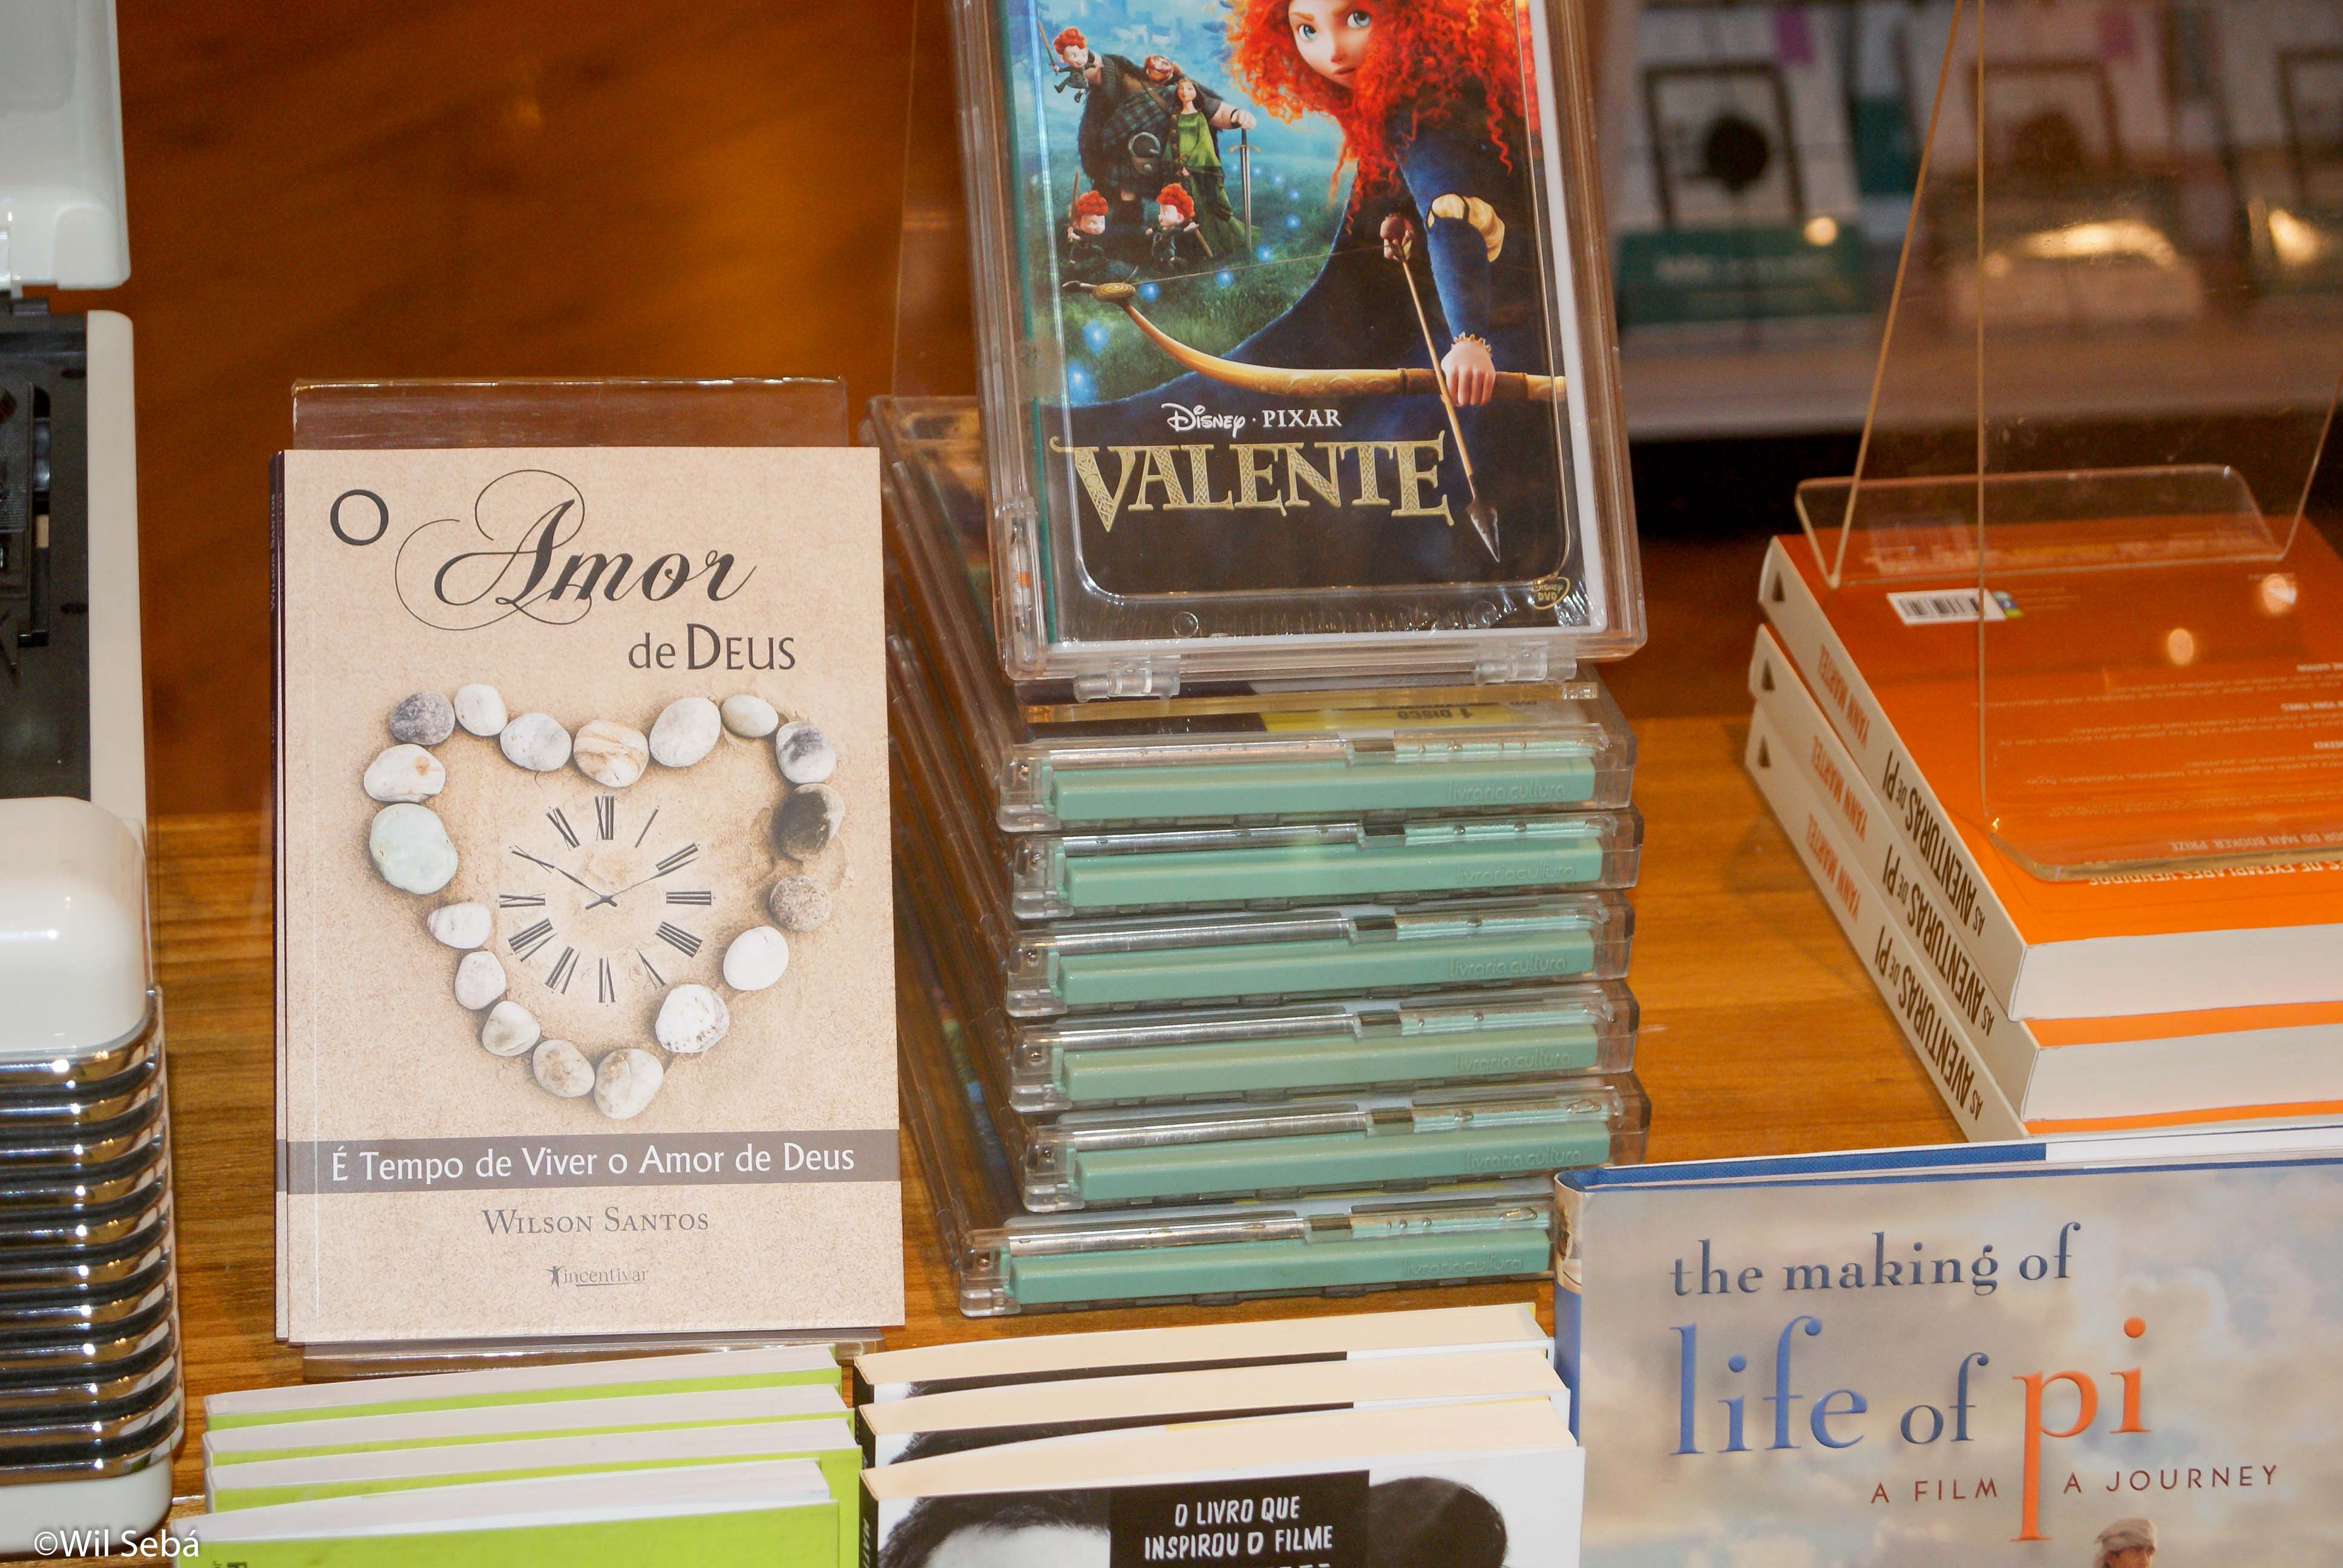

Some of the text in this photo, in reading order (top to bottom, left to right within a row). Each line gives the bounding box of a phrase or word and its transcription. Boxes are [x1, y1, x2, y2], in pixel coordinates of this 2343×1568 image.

[1262, 409, 1342, 428] PIXAR
[1049, 430, 1454, 533] VALENTE
[330, 489, 388, 546] O
[395, 469, 756, 630] Amor
[1537, 592, 1558, 601] DVD
[629, 631, 675, 670] de
[1397, 709, 1453, 720] DISCO
[1818, 642, 1870, 750] YANN MARTEL
[1811, 736, 1868, 842] YANN MARTEL
[1806, 812, 1861, 923] YANN MARTEL
[1883, 750, 1986, 938] AS AVENTURAS DE PI
[1883, 844, 1995, 1037] AS AVENTURAS DE PI
[1875, 926, 1984, 1122] AS AVENTURAS DE PI
[331, 1142, 854, 1186] É Tempo de Viver o Amor de Deus
[483, 1207, 709, 1236] WILSON SANTOS
[563, 1266, 649, 1285] incentivar
[1670, 1221, 2081, 1296] the making of
[1670, 1315, 2151, 1542] life of pi
[1175, 1495, 1300, 1528] O LIVRO QUE
[1871, 1465, 2279, 1504] A FILM A JOURNEY
[1144, 1525, 1333, 1561] INSPIROU O FILME
